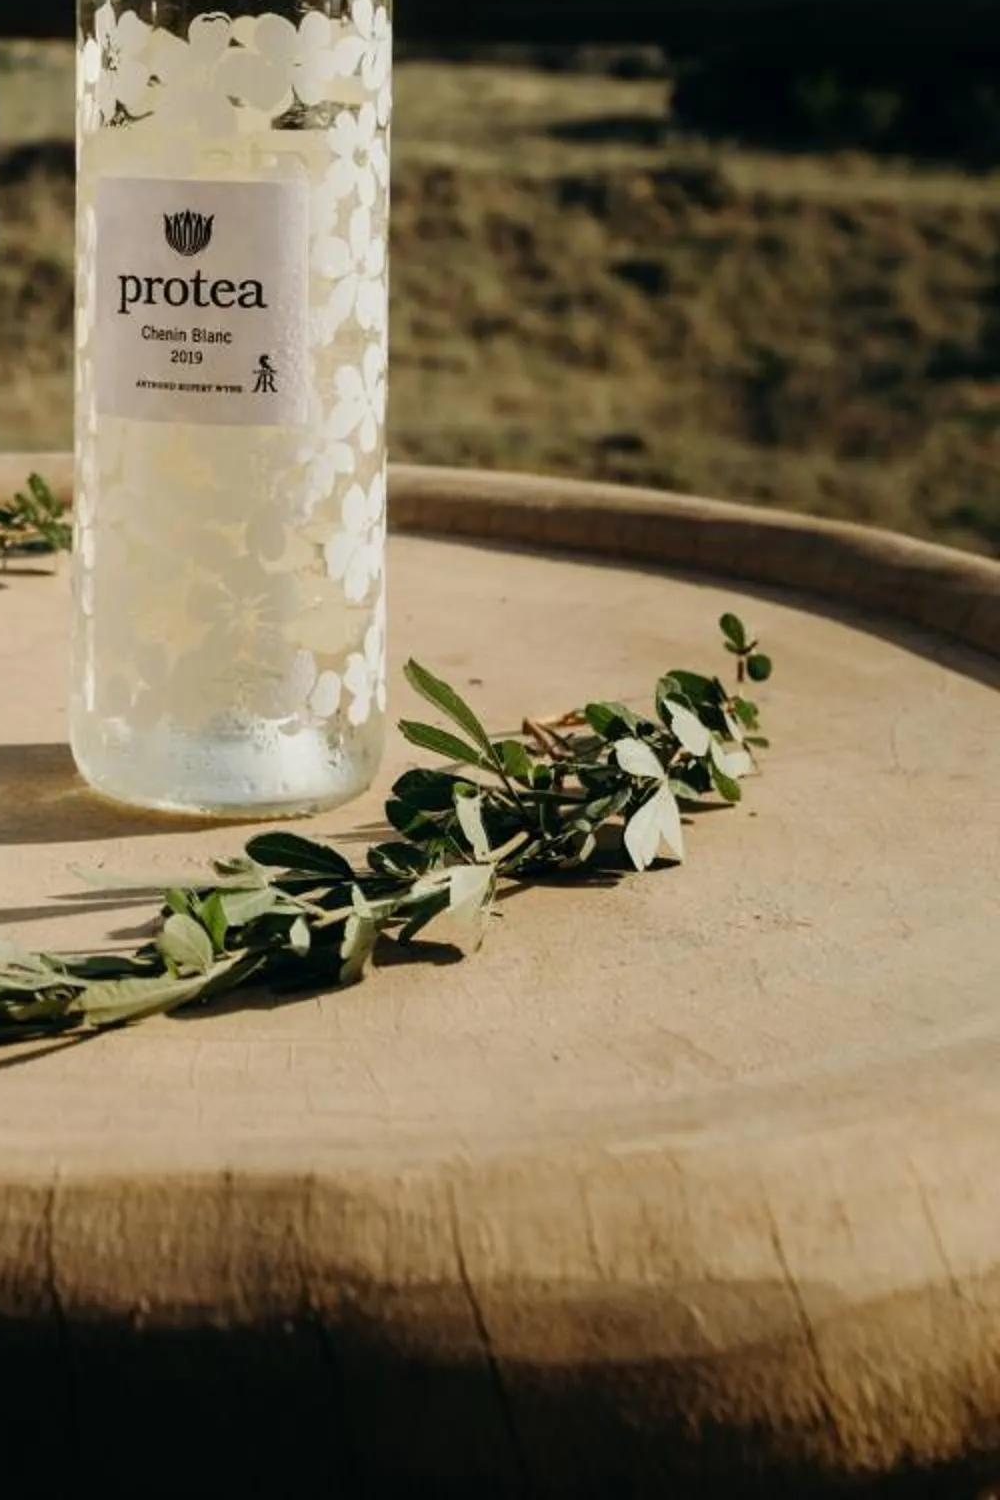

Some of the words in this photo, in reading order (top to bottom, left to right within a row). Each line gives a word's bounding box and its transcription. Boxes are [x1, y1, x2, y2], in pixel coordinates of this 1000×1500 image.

[117, 269, 268, 315] protea
[140, 325, 187, 342] Chenin
[191, 327, 232, 344] Blanc
[170, 350, 203, 365] 2019
